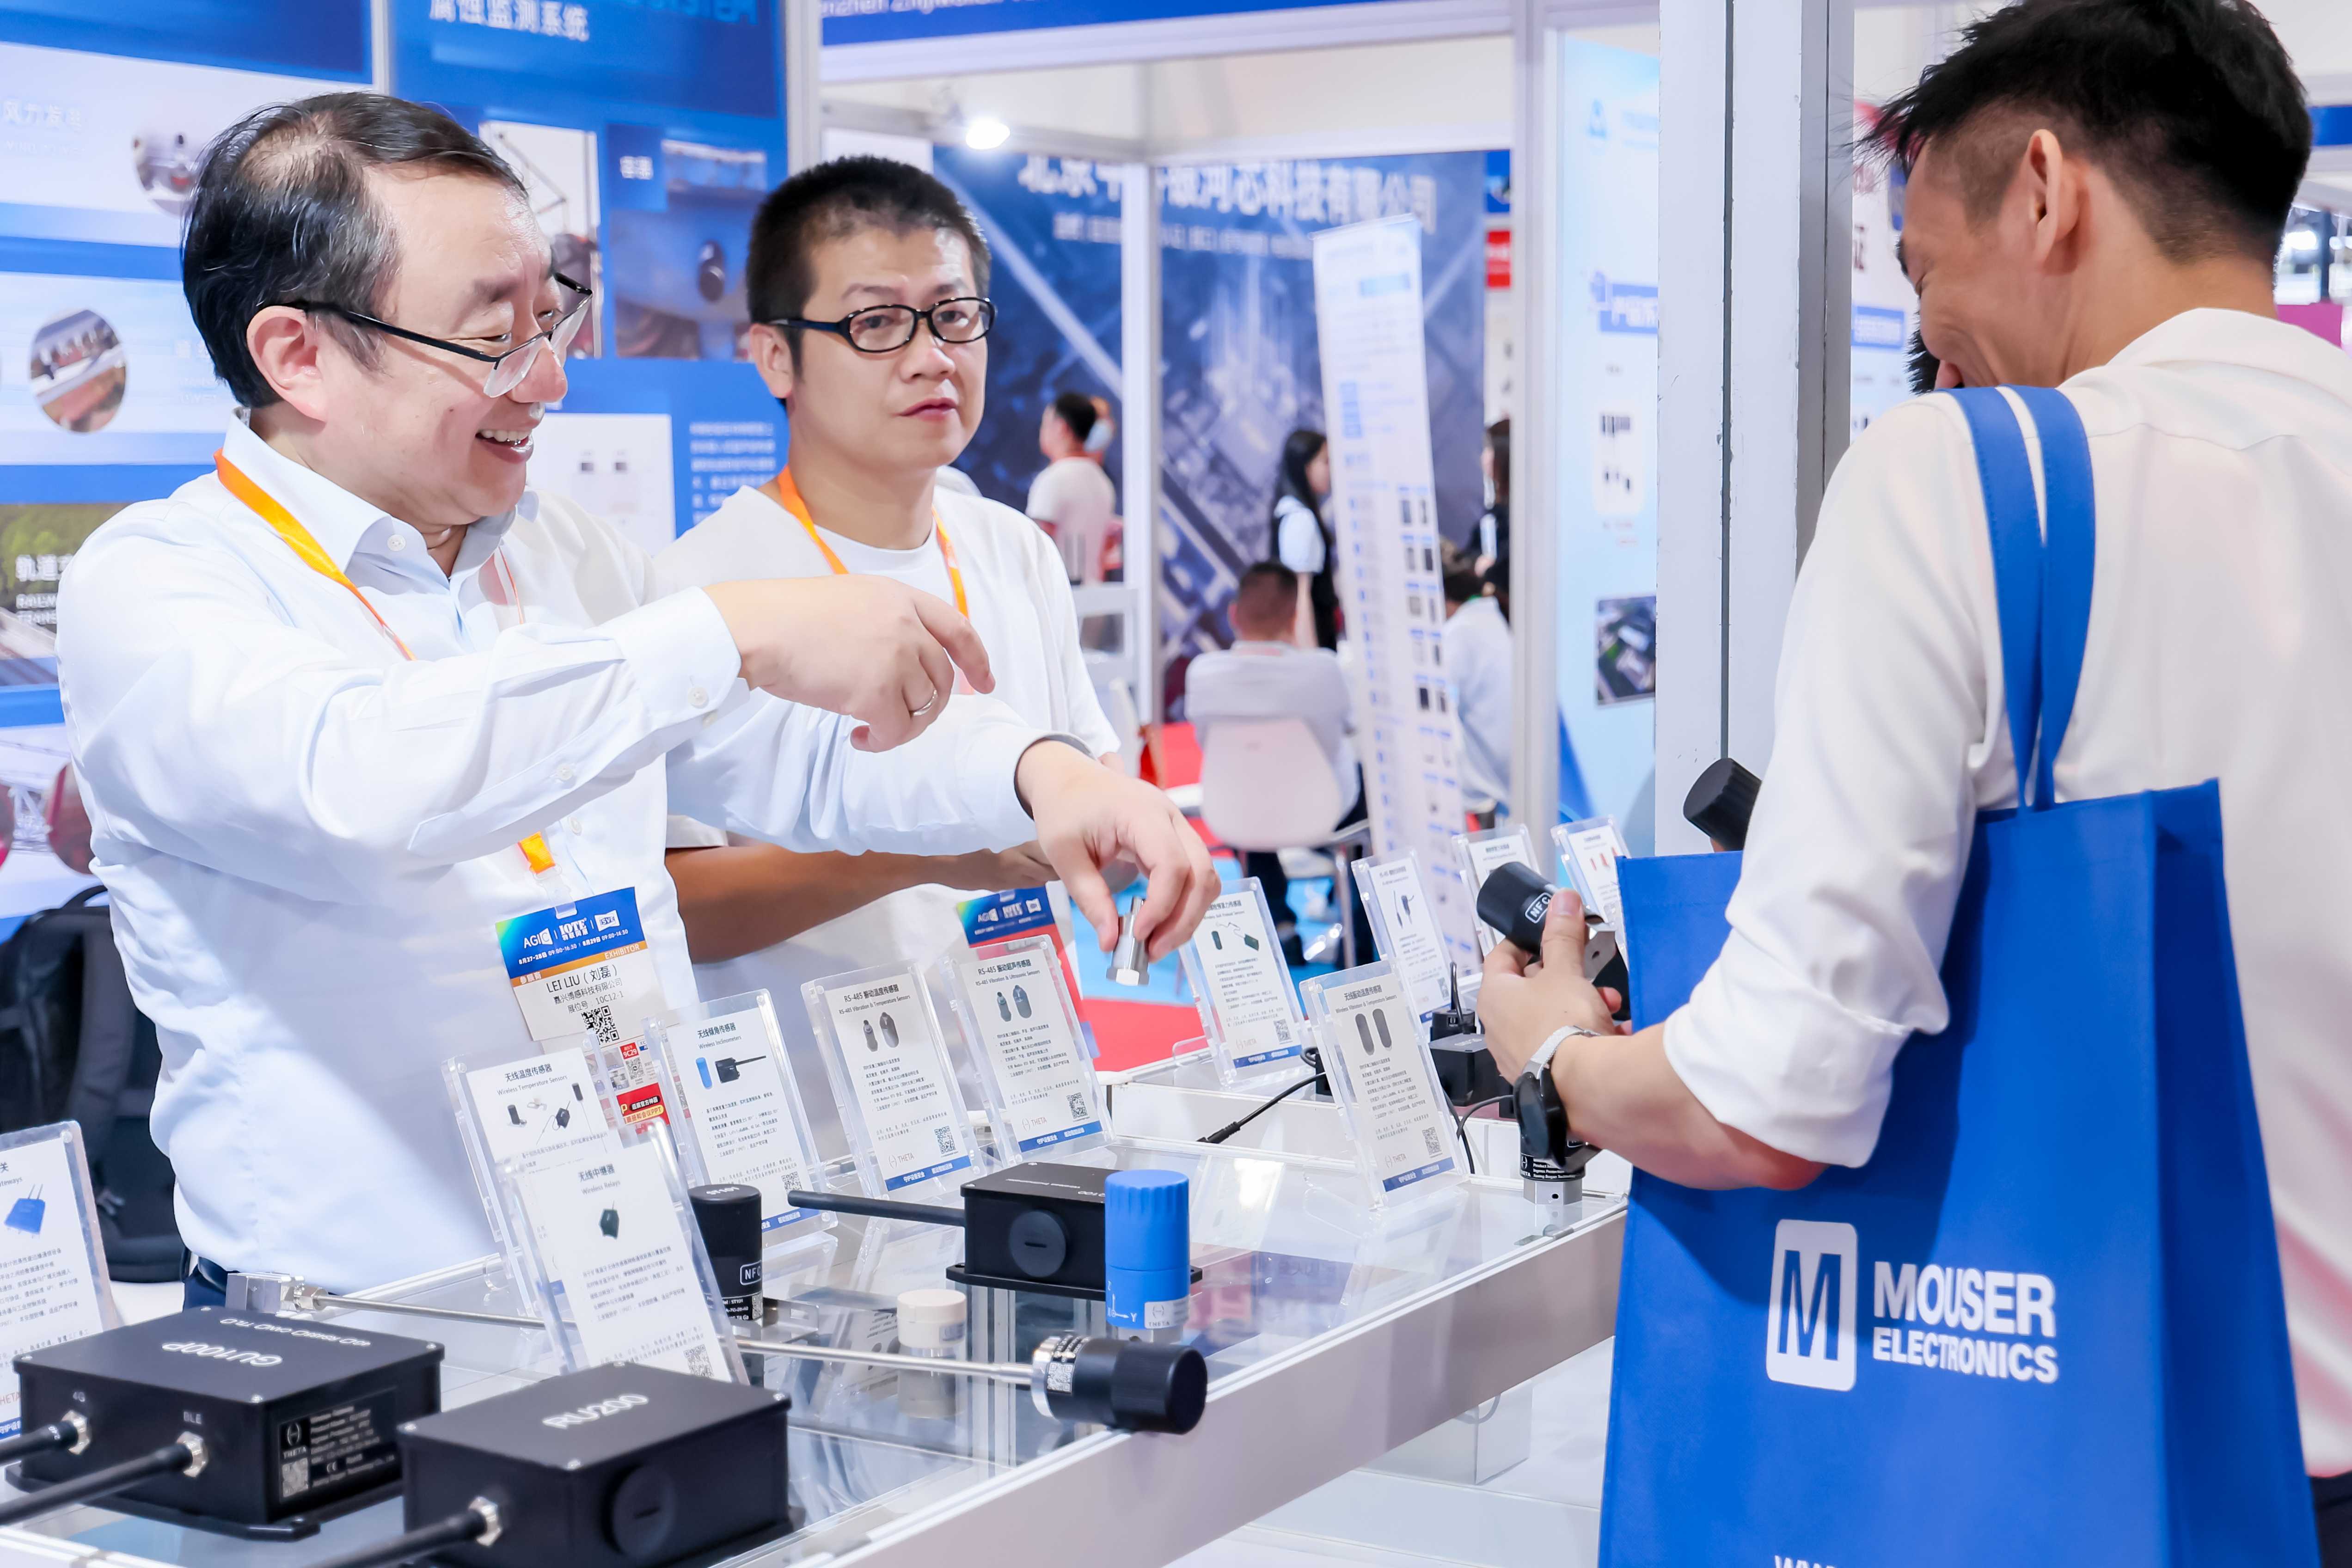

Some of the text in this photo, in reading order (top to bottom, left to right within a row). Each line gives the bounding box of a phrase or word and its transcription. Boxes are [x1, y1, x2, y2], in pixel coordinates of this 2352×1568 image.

[1530, 897, 1551, 918] NFC
[559, 919, 586, 935] IOTE
[604, 943, 640, 960] EXHIBITOR
[978, 966, 997, 976] RS-485
[546, 979, 562, 993] LEI
[565, 974, 581, 988] LIU
[553, 978, 623, 1005] 嘉兴博感科技有限公司
[596, 991, 624, 1005] 10C12-1
[844, 984, 900, 1003] RS-485 振动温度传感器
[852, 1004, 870, 1012] Vibration
[874, 997, 896, 1007] Temperature
[896, 994, 911, 1002] Sensors
[697, 1022, 736, 1039] 无线倾角传感器
[698, 1035, 742, 1050] Wireless Inclinometers
[623, 1049, 637, 1057] 9C29
[504, 1063, 552, 1083] 无线温度传感器
[497, 1074, 568, 1096] Wireless Temperature Sensors
[1031, 1116, 1047, 1127] THETA
[897, 1152, 915, 1163] THETA
[578, 1163, 615, 1182] 无线中继器
[581, 1180, 621, 1195] Wireless Relays
[706, 1186, 740, 1196] ST101
[1874, 1261, 2056, 1337] MOUSER
[1130, 1312, 1137, 1323] Y
[161, 1342, 283, 1367] GU100P
[1873, 1326, 2059, 1384] ELECTRONICS
[183, 1410, 202, 1425] BLE
[542, 1393, 649, 1430] RU200
